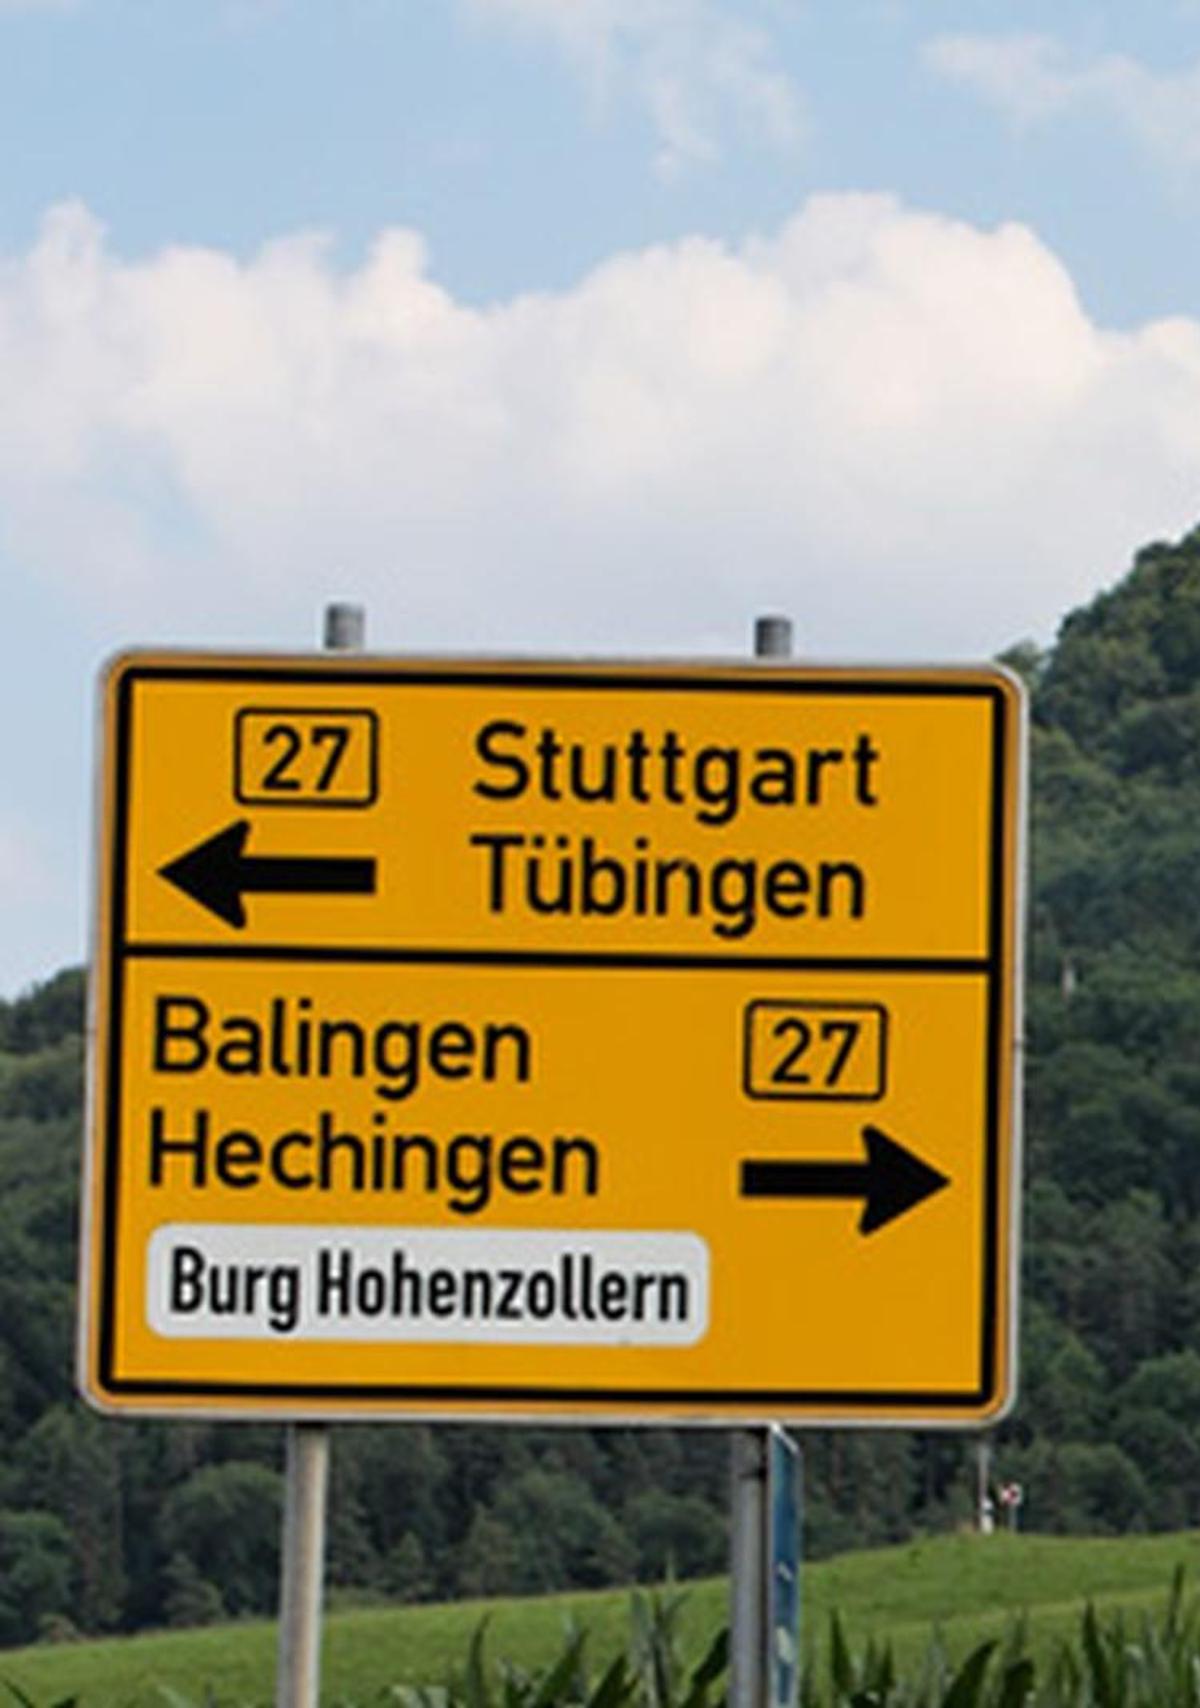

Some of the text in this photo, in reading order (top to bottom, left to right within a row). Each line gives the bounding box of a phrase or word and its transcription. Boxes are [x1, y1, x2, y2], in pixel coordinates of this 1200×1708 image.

[262, 724, 350, 792] 27
[473, 720, 879, 827] Stuttgart
[469, 833, 865, 940] Tübingen
[153, 995, 530, 1102] Balingen
[771, 1017, 860, 1087] 27
[149, 1107, 599, 1215] Hechingen
[172, 1247, 687, 1332] Burg Hohenzollern
